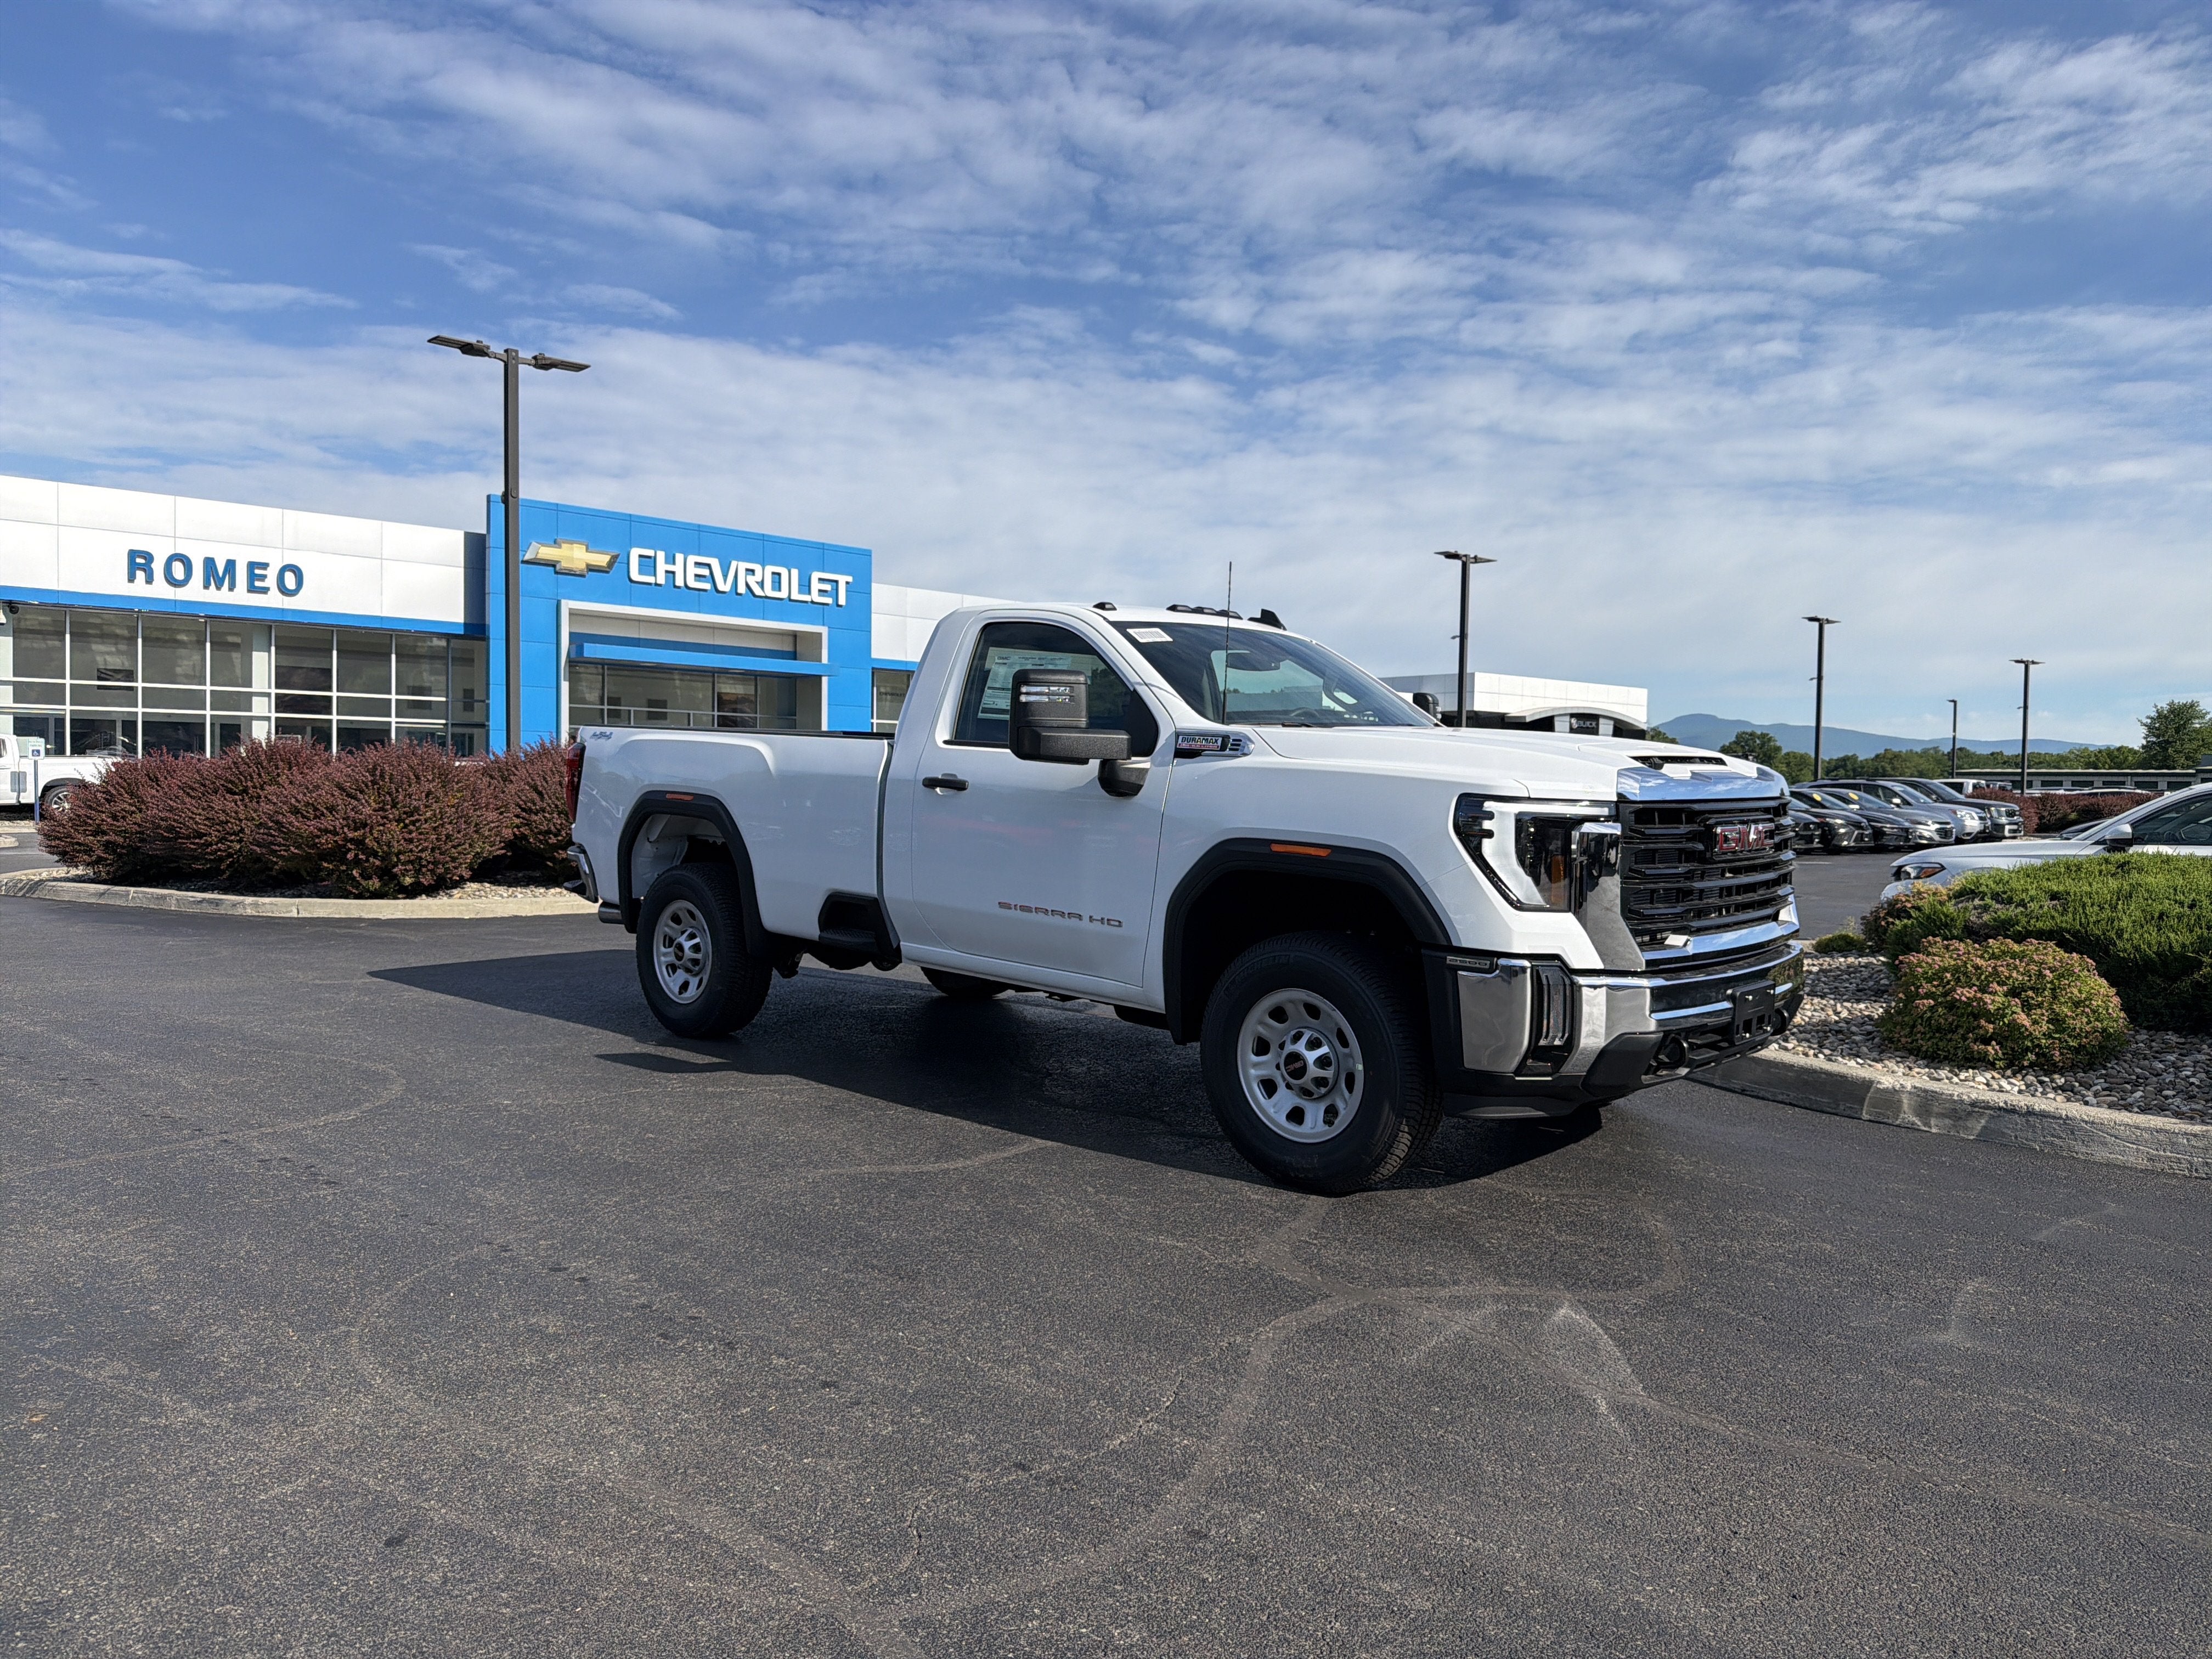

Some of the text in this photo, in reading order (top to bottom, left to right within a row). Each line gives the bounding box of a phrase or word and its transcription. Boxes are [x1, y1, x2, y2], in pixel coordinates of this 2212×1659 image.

[127, 549, 304, 597] ROMEO
[628, 548, 853, 607] CHEVROLET
[1181, 736, 1220, 745] DURAMAX
[1716, 823, 1775, 852] GMC
[998, 901, 1123, 928] SIERRA HD
